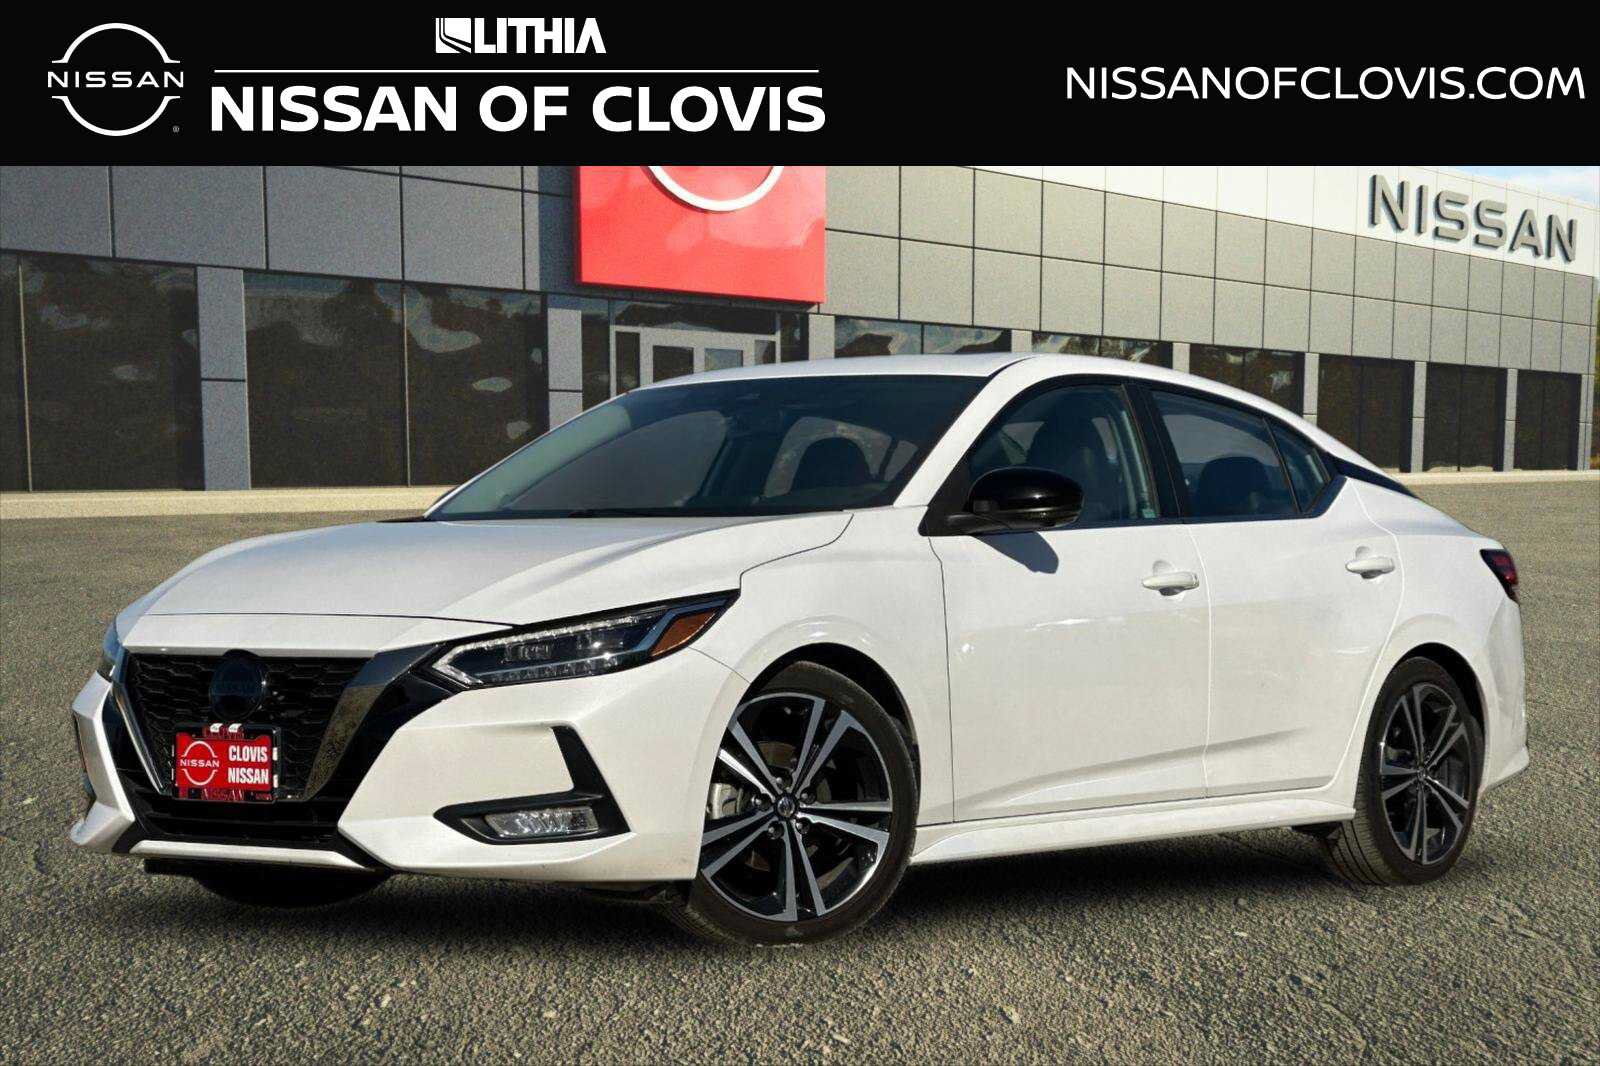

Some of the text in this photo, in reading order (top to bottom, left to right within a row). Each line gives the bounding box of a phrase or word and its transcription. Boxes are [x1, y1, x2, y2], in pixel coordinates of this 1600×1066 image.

[1368, 174, 1577, 262] NISSAN
[228, 745, 268, 763] CLOVIS
[180, 759, 220, 768] NISSAN
[228, 767, 269, 785] NISSAN
